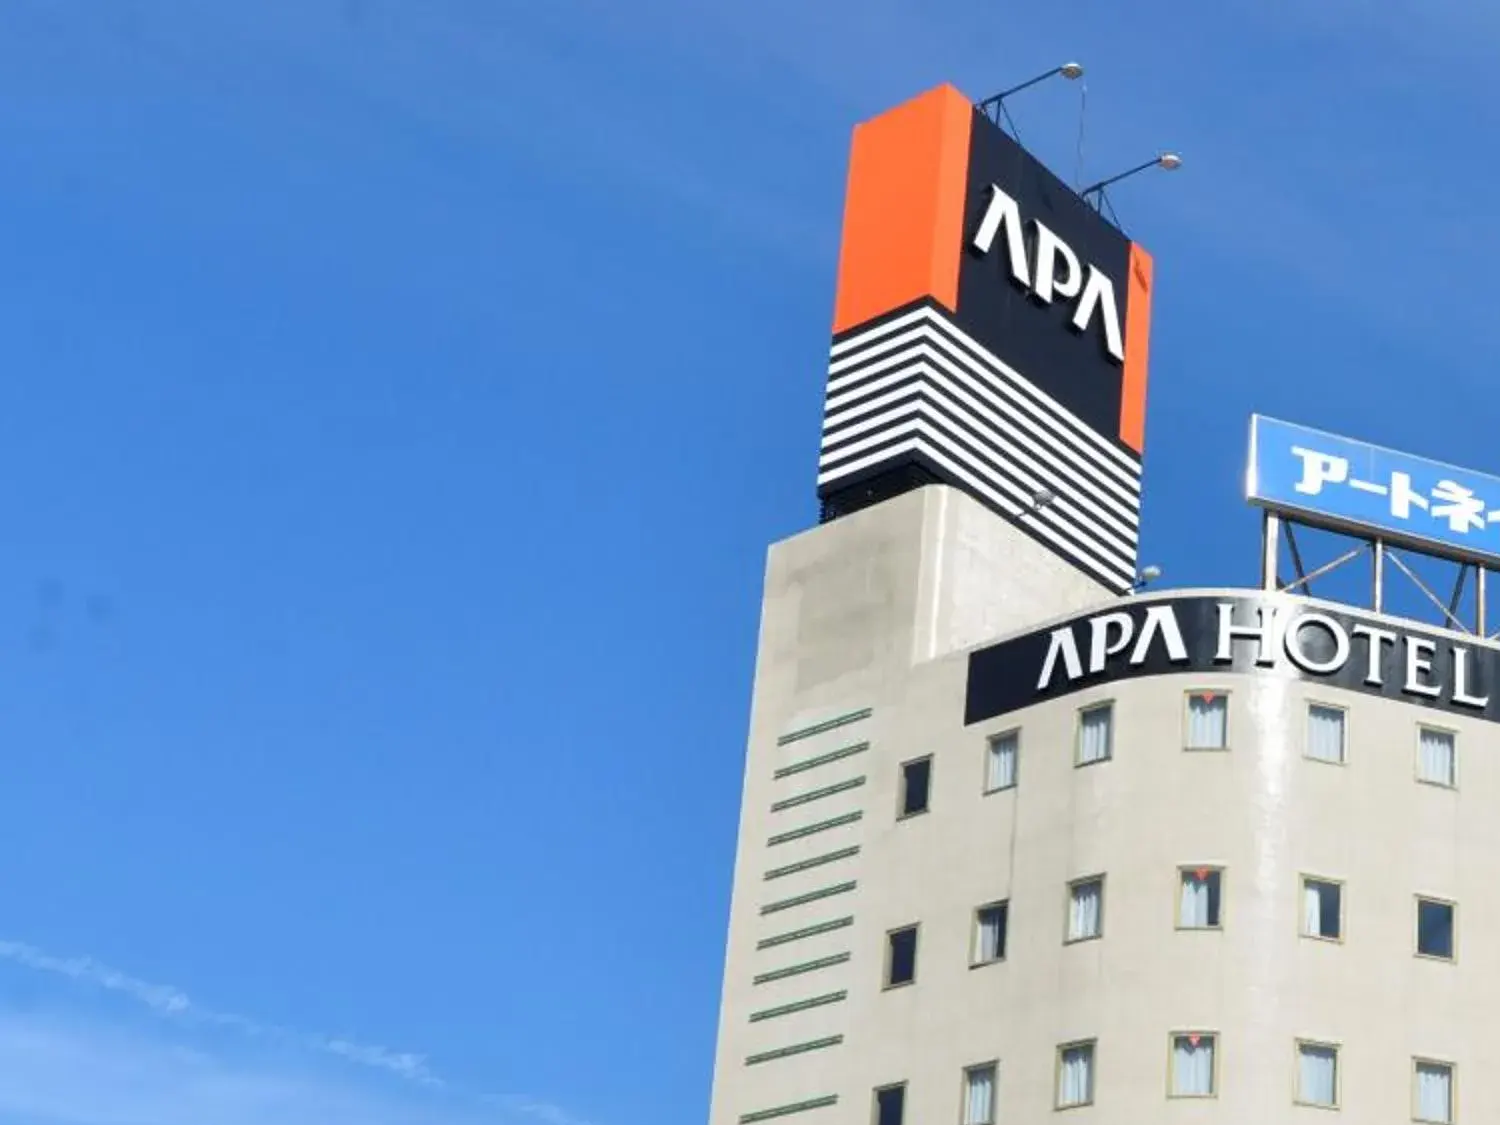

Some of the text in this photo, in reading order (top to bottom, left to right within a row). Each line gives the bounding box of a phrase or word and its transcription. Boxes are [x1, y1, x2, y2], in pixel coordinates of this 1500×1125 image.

[973, 182, 1125, 361] APA
[1037, 602, 1489, 707] APA HOTEL
